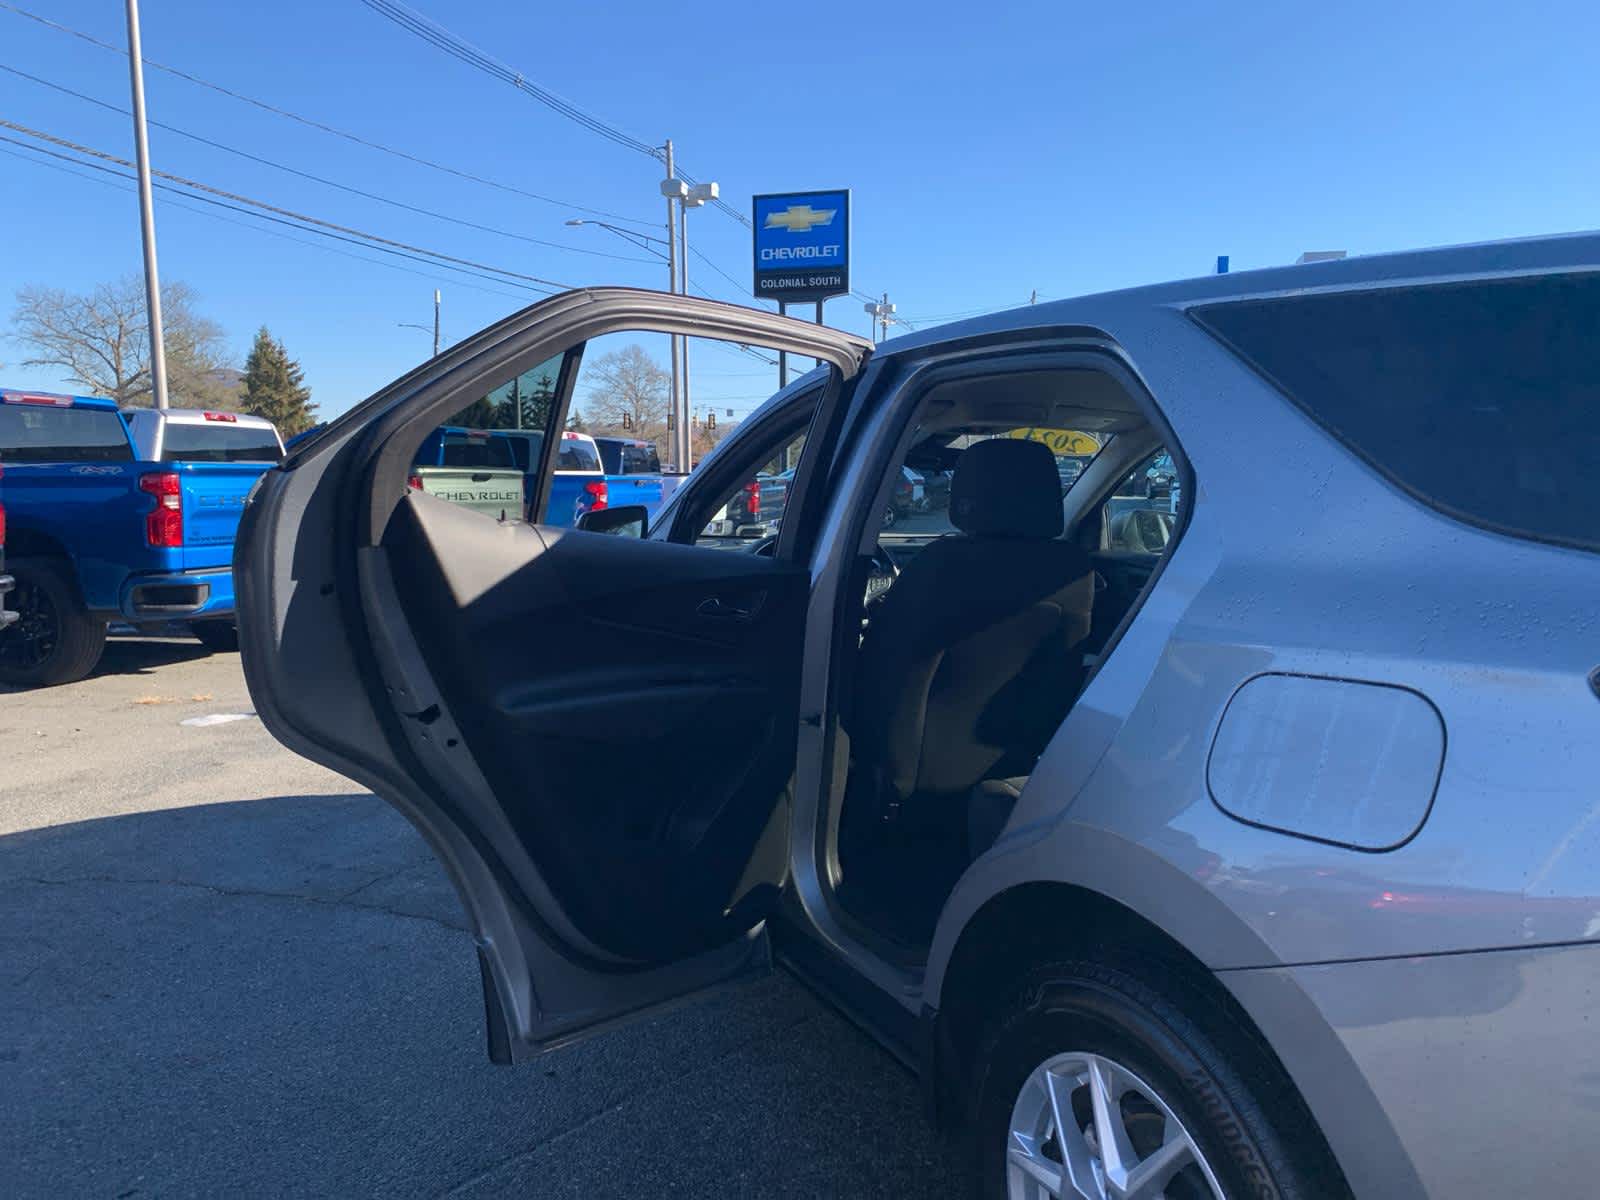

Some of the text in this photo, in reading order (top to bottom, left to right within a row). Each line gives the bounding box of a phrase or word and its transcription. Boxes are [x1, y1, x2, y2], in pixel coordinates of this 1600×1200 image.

[760, 245, 840, 260] CHEVROLET
[761, 277, 841, 288] COLONIAL SOUTH
